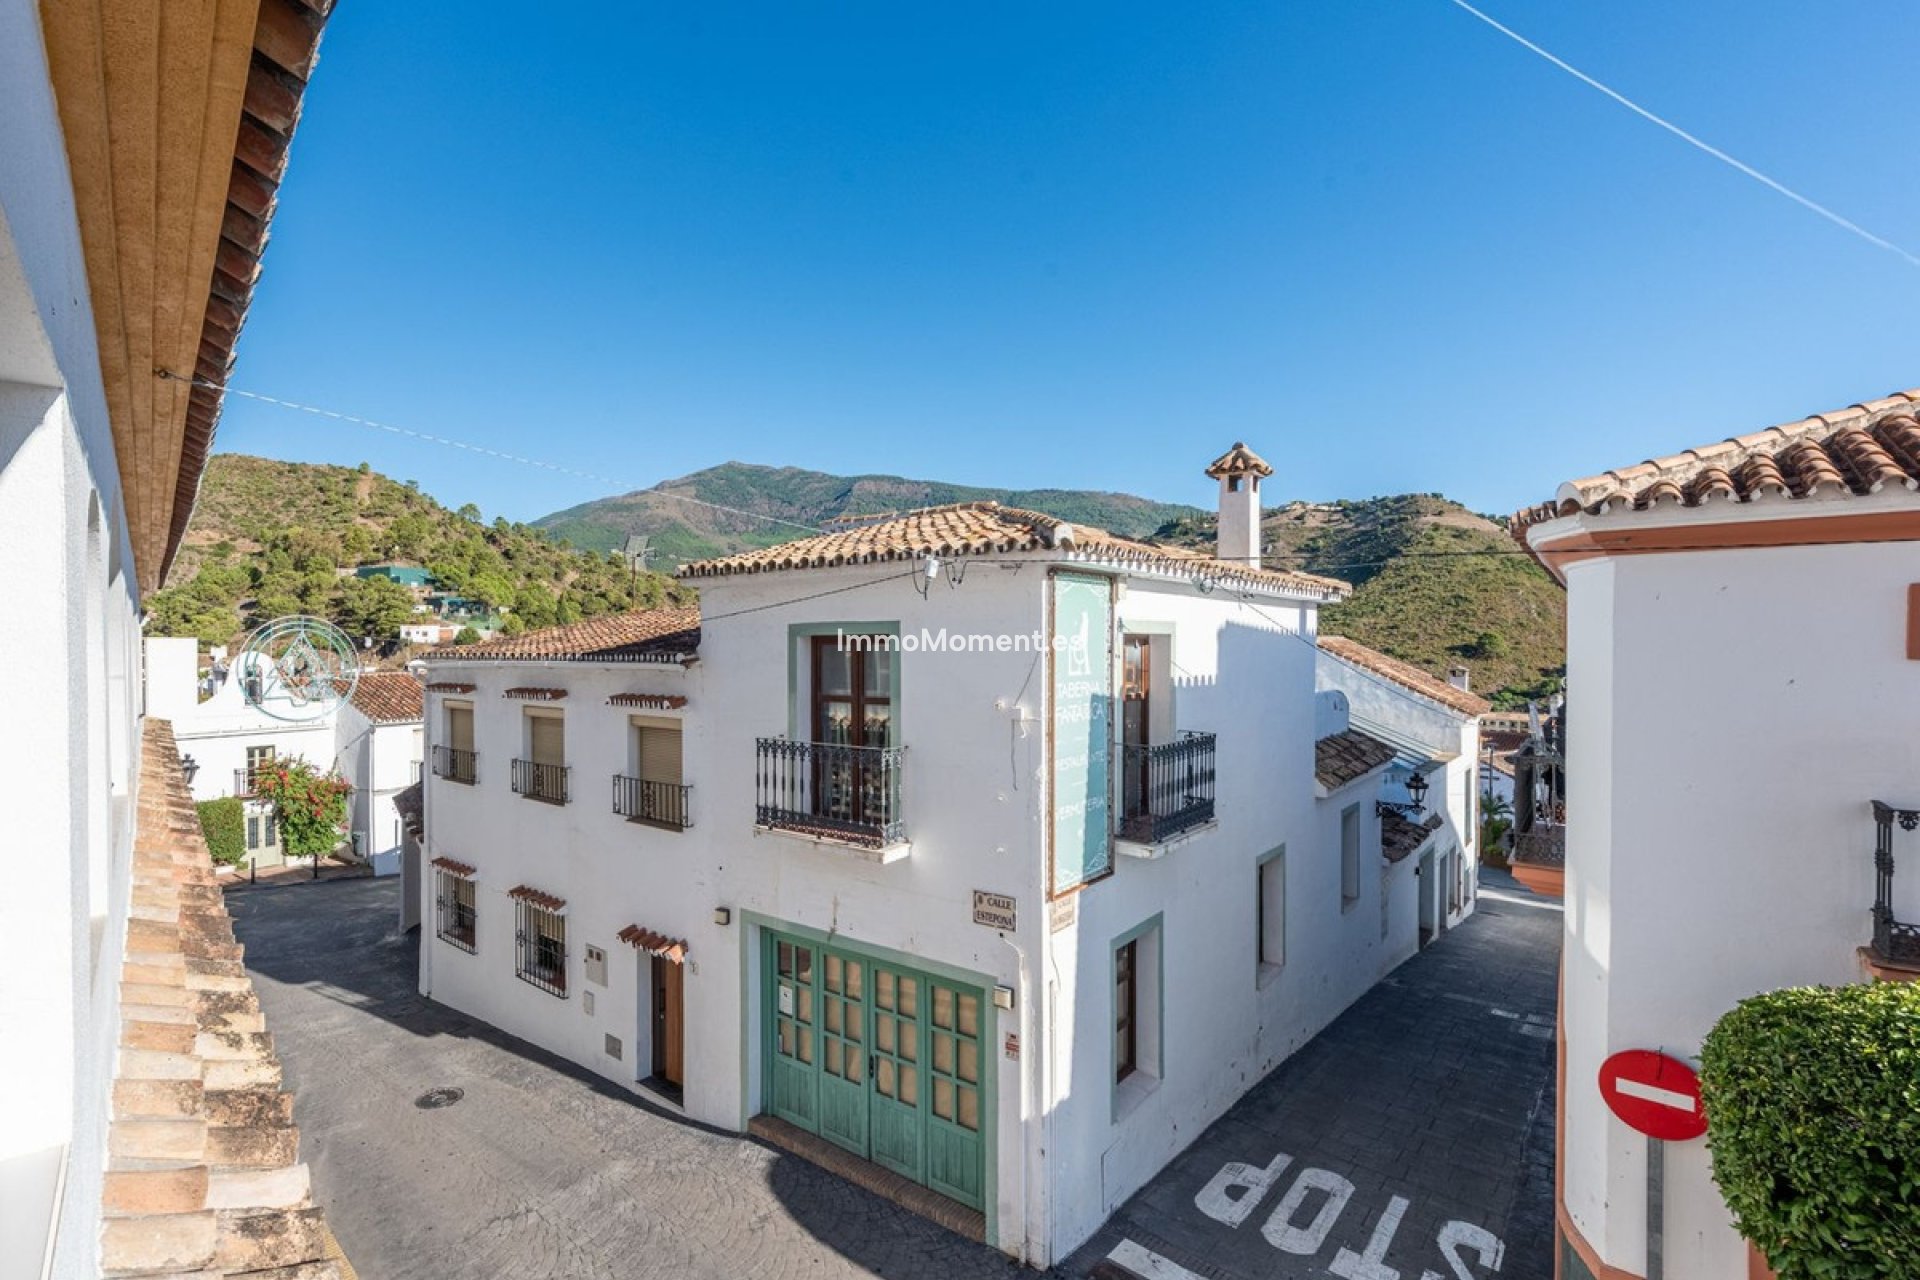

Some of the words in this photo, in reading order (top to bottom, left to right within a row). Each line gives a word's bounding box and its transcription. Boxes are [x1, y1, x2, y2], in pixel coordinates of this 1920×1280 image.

[987, 898, 1012, 910] CALLE
[976, 910, 1012, 926] ESTEPONA
[1195, 1152, 1506, 1280] STOP
